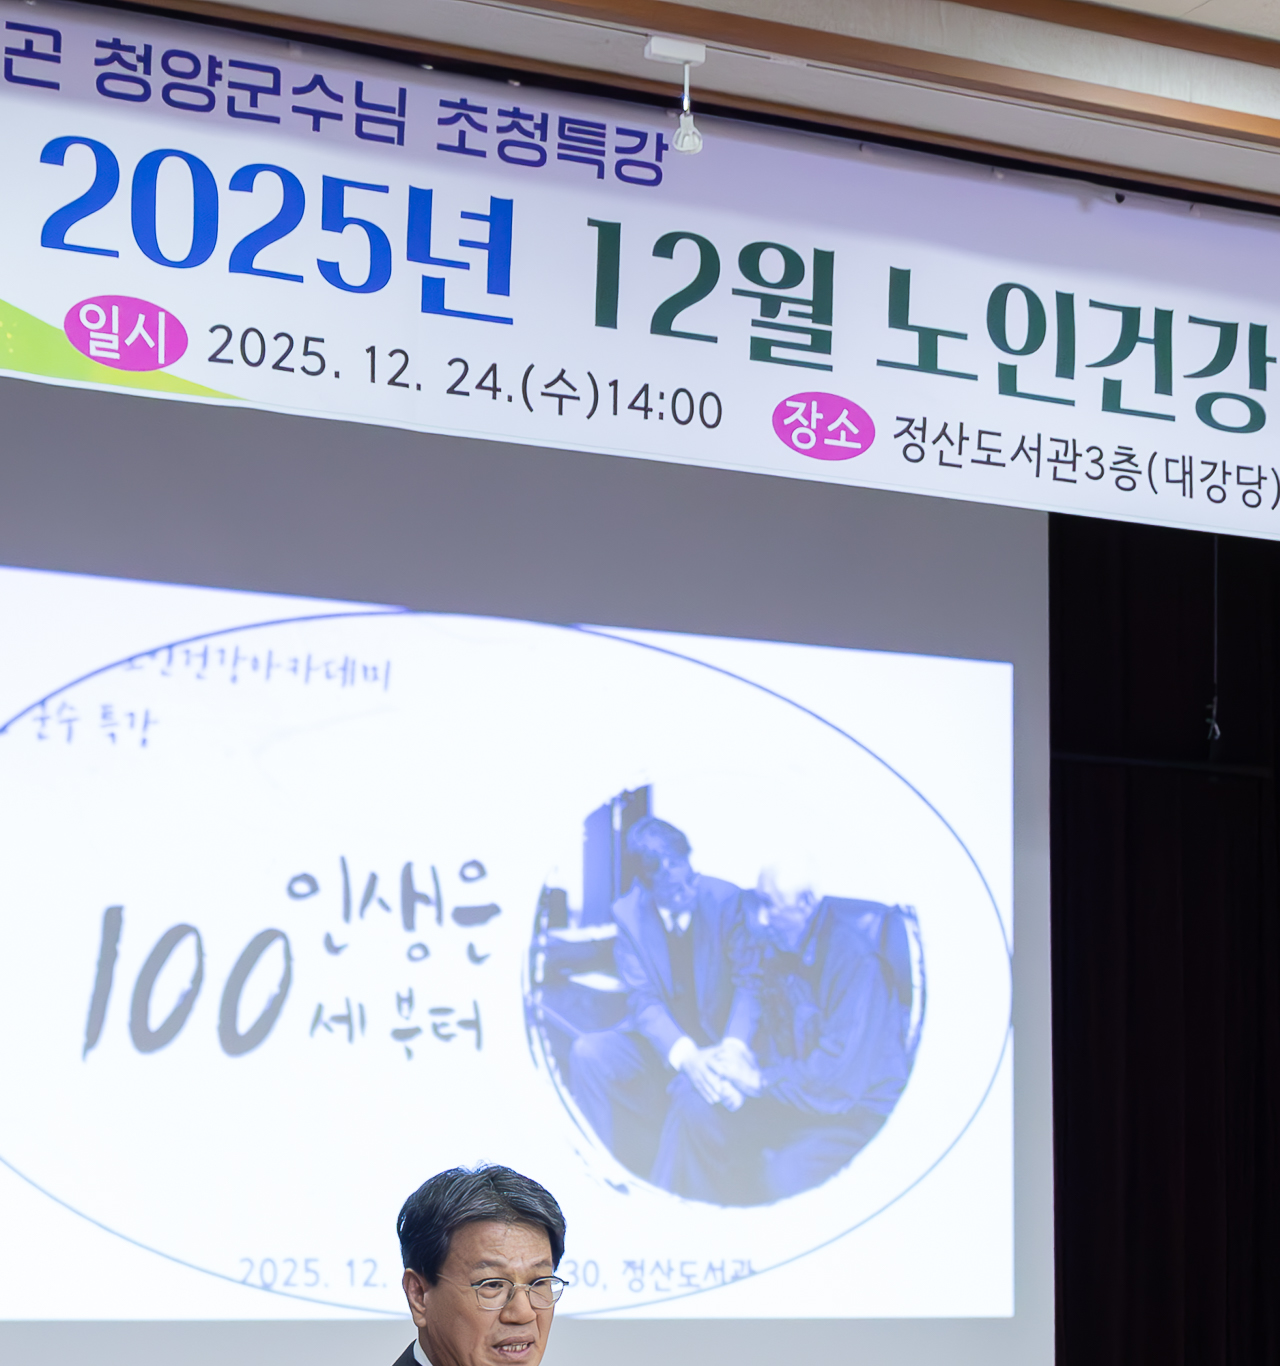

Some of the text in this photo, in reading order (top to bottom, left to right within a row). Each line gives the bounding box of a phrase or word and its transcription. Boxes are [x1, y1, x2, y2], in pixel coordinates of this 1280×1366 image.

[94, 37, 407, 147] 청양군수님
[436, 97, 669, 187] 초청특강
[39, 135, 515, 326] 2025년
[587, 216, 835, 372] 12월
[876, 265, 1278, 434] 노인건강
[77, 302, 166, 365] 일시
[207, 324, 341, 379] 2025.
[365, 345, 422, 391] 12.
[782, 399, 863, 450] 장소
[287, 855, 503, 965] 인생은
[82, 905, 293, 1062] 100
[239, 1257, 329, 1290] 2025.
[346, 1258, 388, 1289] 12.
